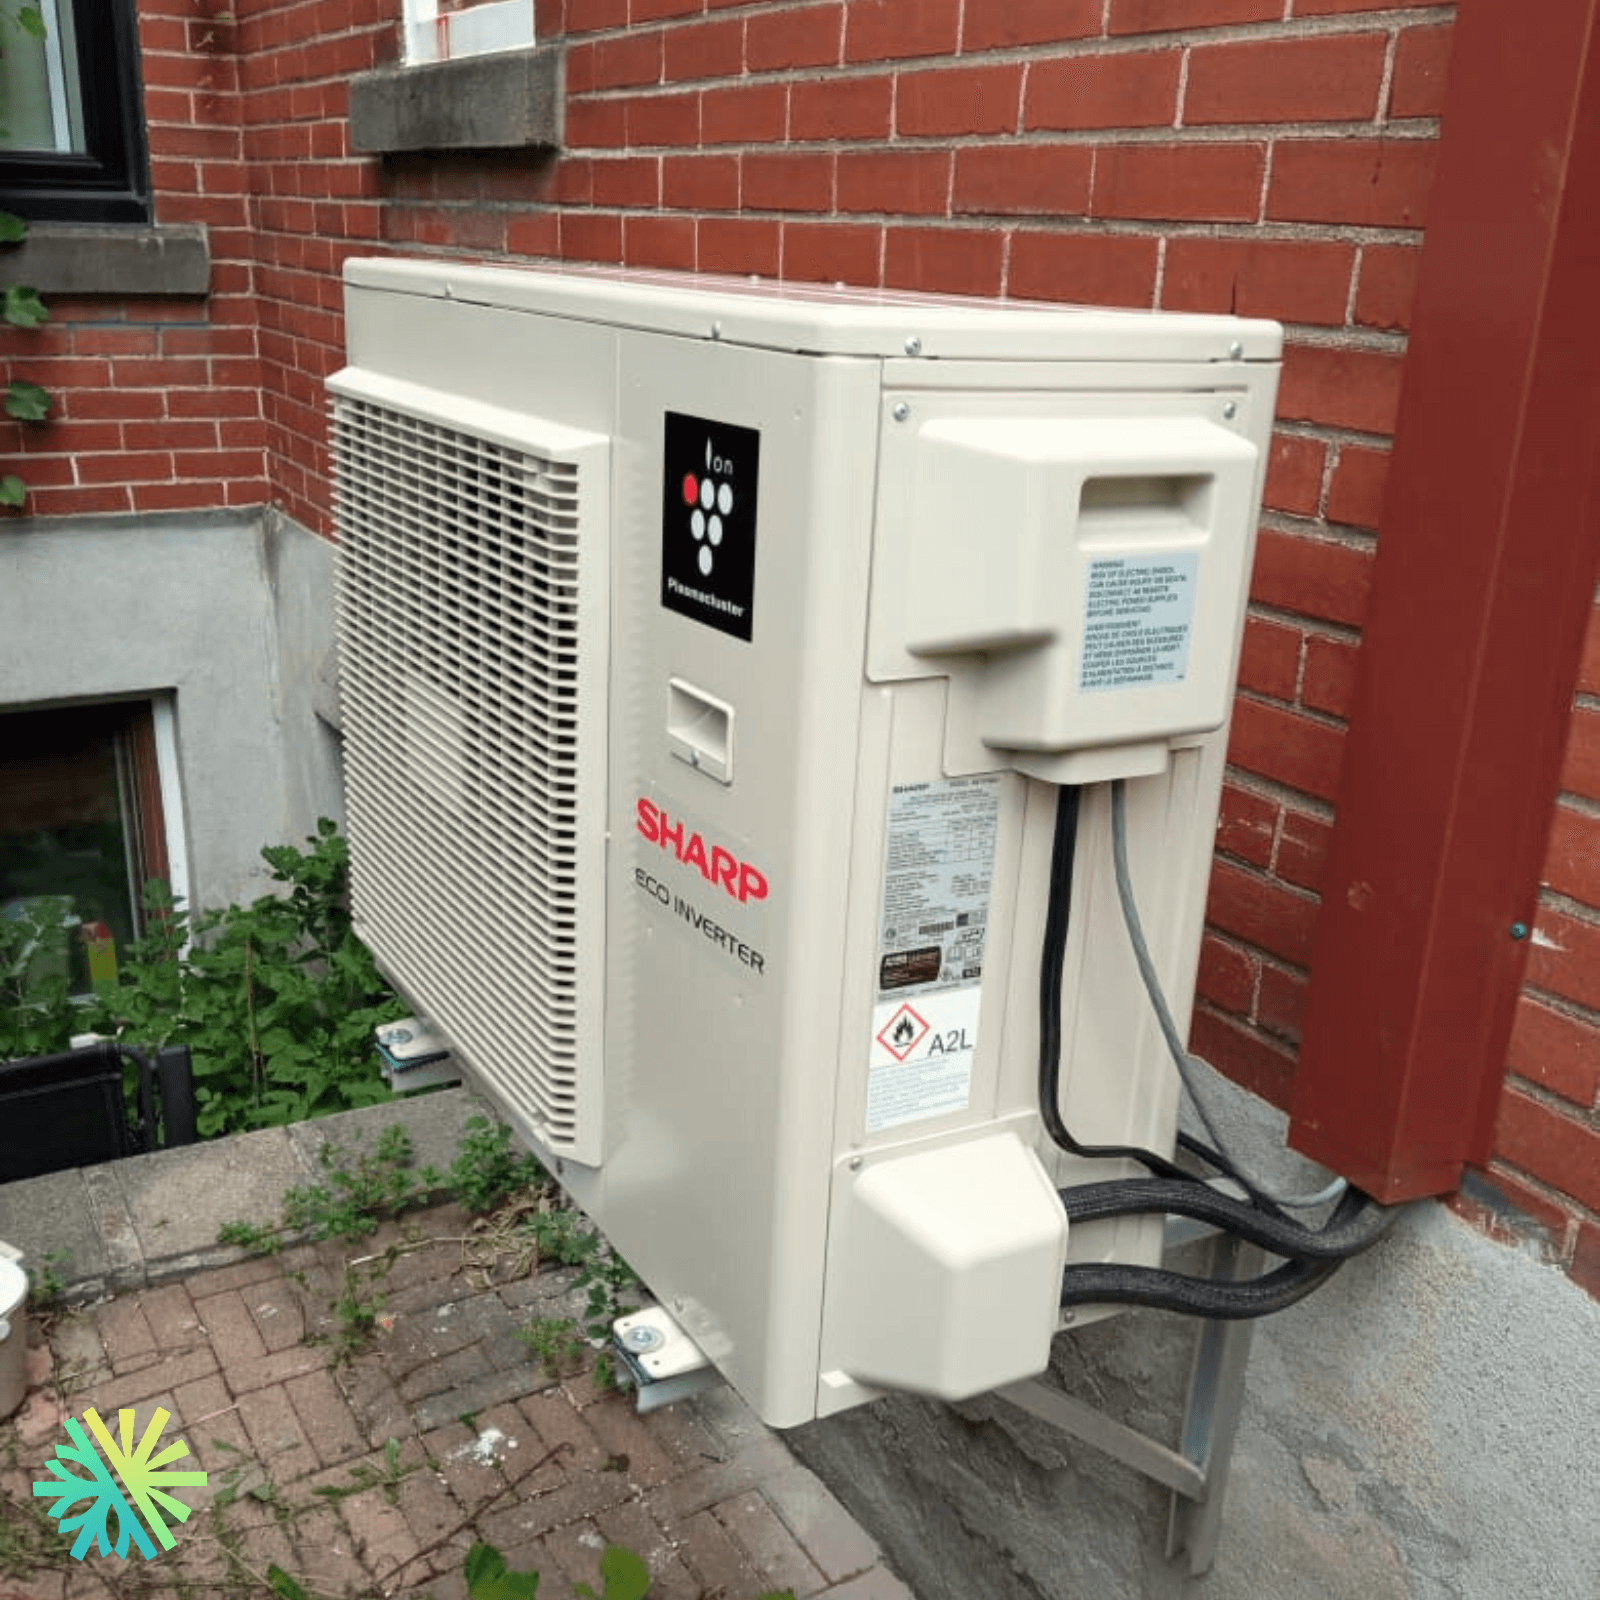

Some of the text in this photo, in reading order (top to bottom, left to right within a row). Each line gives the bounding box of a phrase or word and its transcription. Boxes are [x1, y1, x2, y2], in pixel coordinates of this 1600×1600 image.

[668, 576, 745, 617] Plasmacluster
[637, 797, 769, 904] SHARP
[634, 867, 764, 976] ECO INVERTER
[928, 1027, 974, 1057] A2L
